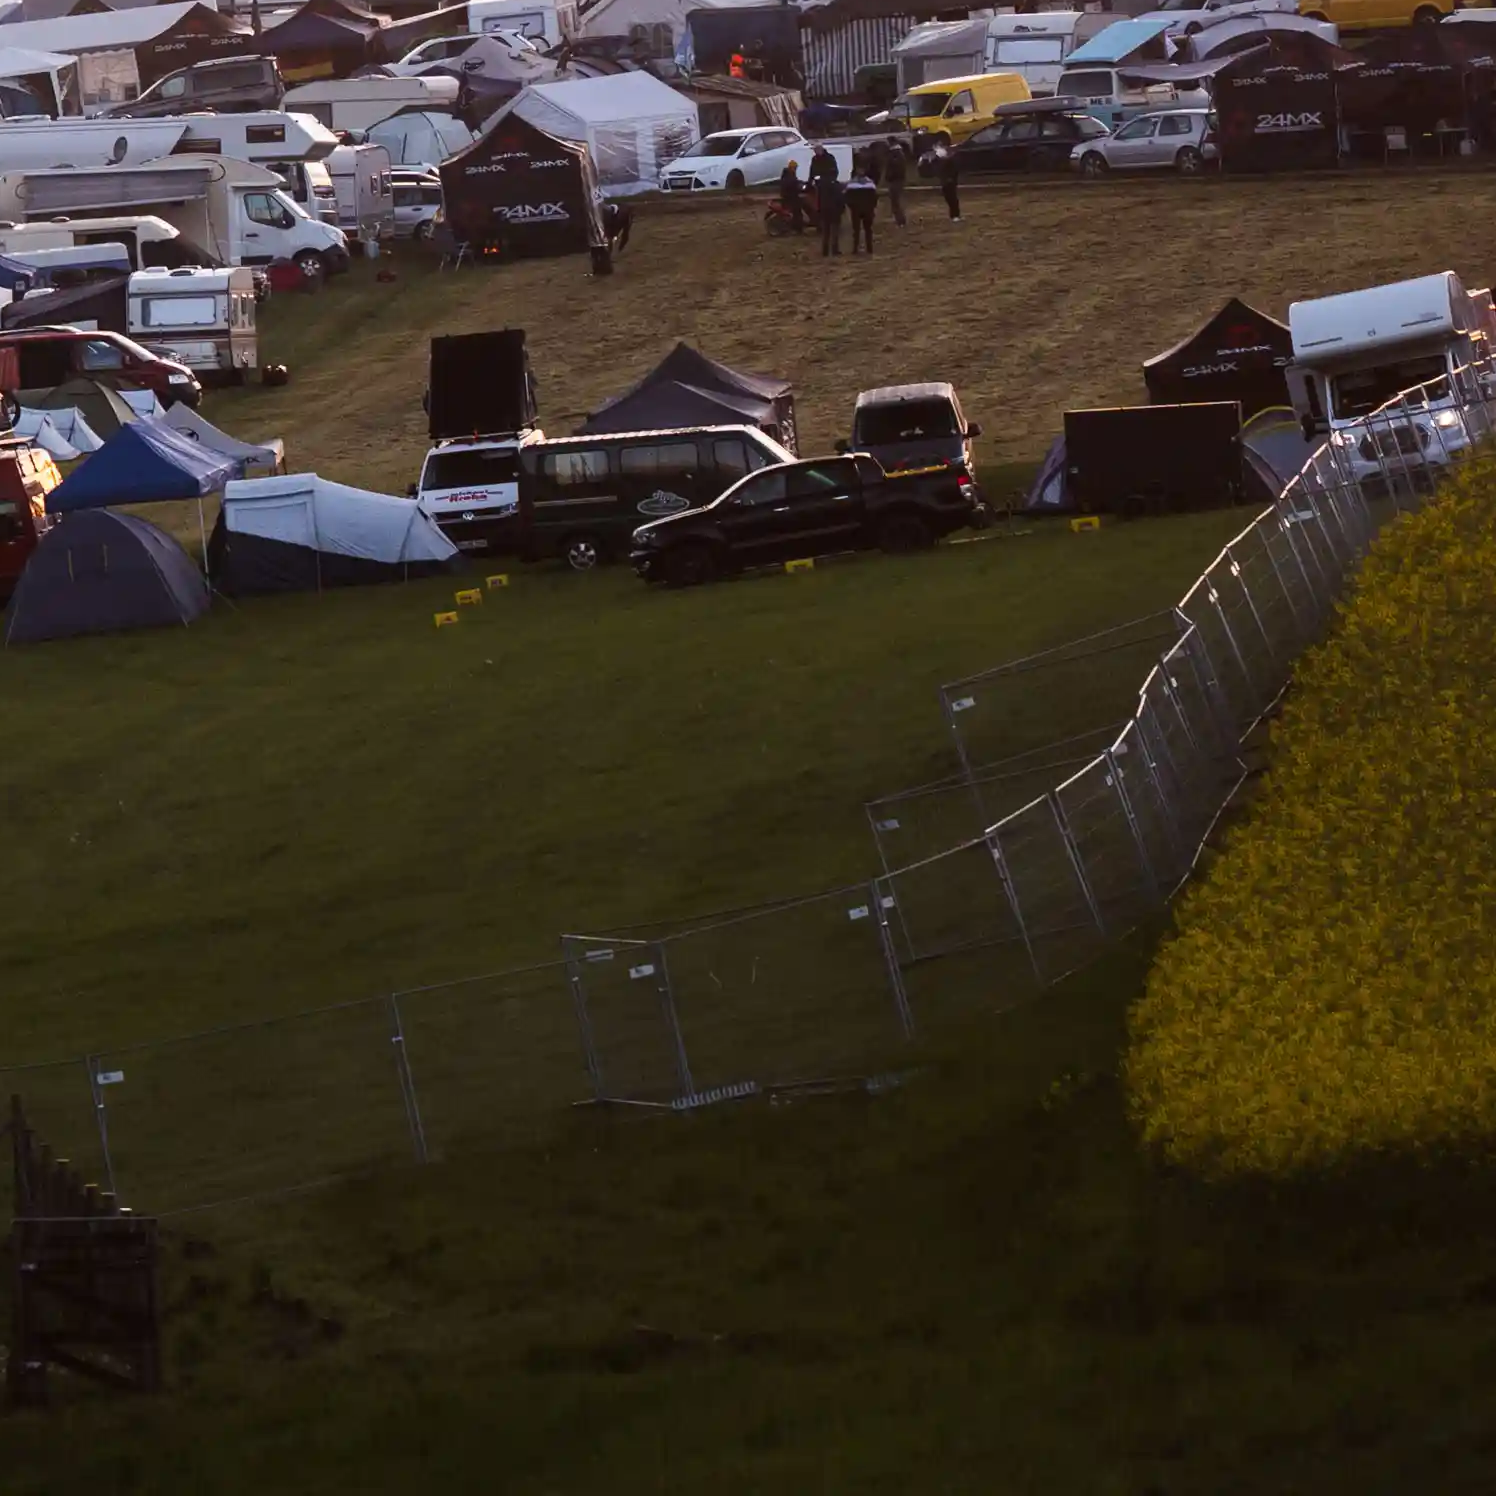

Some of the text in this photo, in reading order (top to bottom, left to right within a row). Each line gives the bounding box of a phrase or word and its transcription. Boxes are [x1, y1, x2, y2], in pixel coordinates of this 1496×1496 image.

[1256, 111, 1322, 127] 24MX
[492, 201, 565, 219] 24MX
[1182, 361, 1239, 378] 24MX
